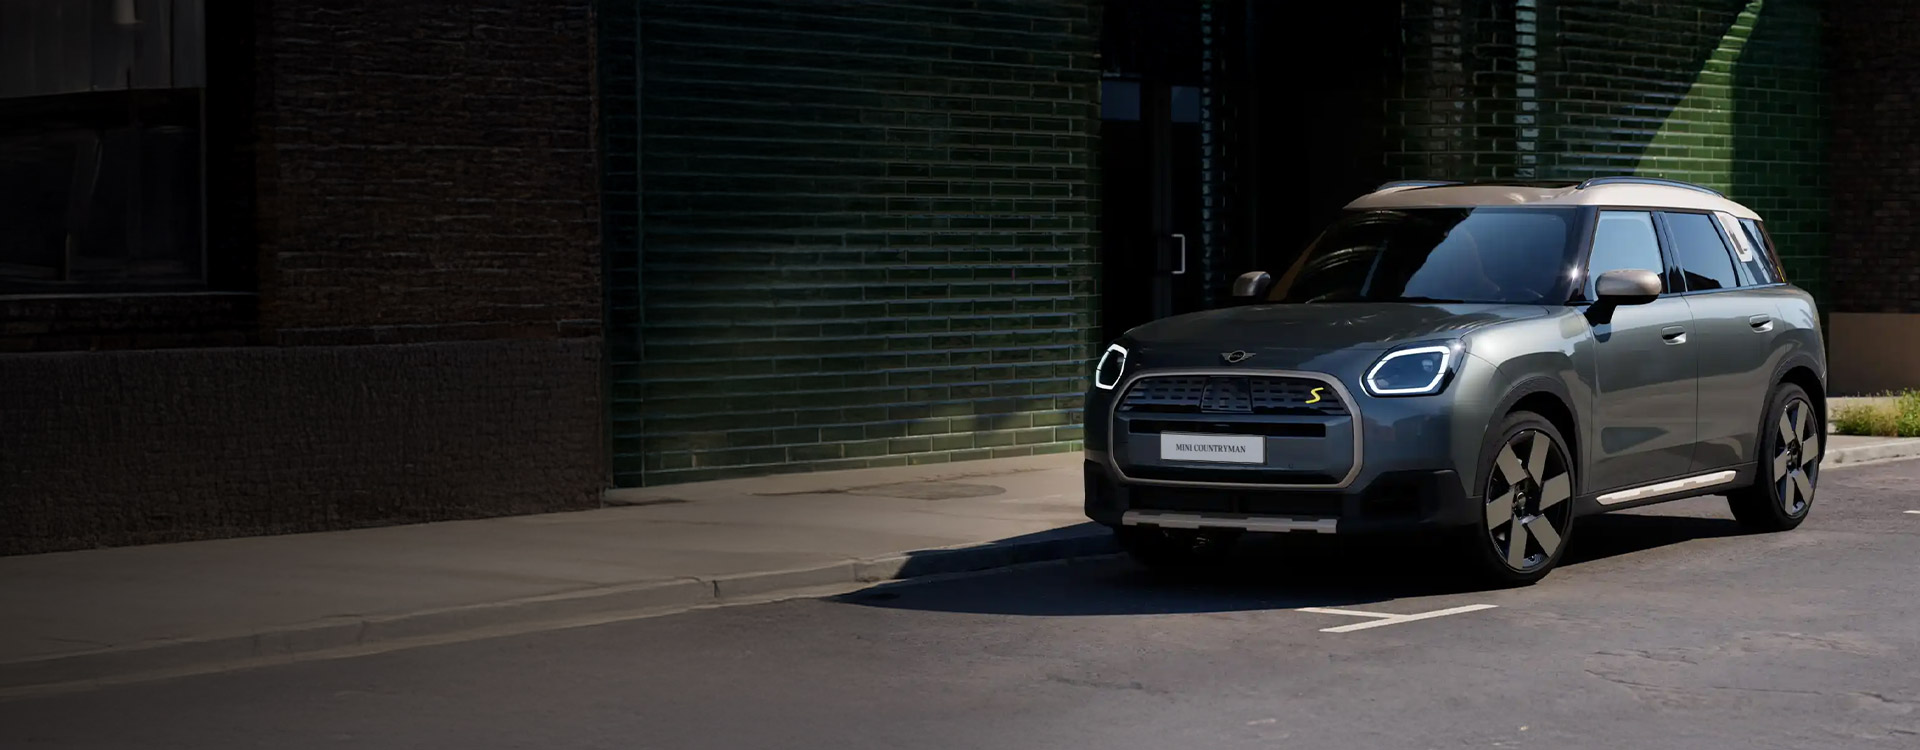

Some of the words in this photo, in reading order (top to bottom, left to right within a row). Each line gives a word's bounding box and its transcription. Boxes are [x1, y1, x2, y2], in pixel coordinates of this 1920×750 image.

[1305, 387, 1324, 404] S
[1176, 443, 1193, 452] MINI
[1194, 444, 1246, 453] COUNTRYMAN
